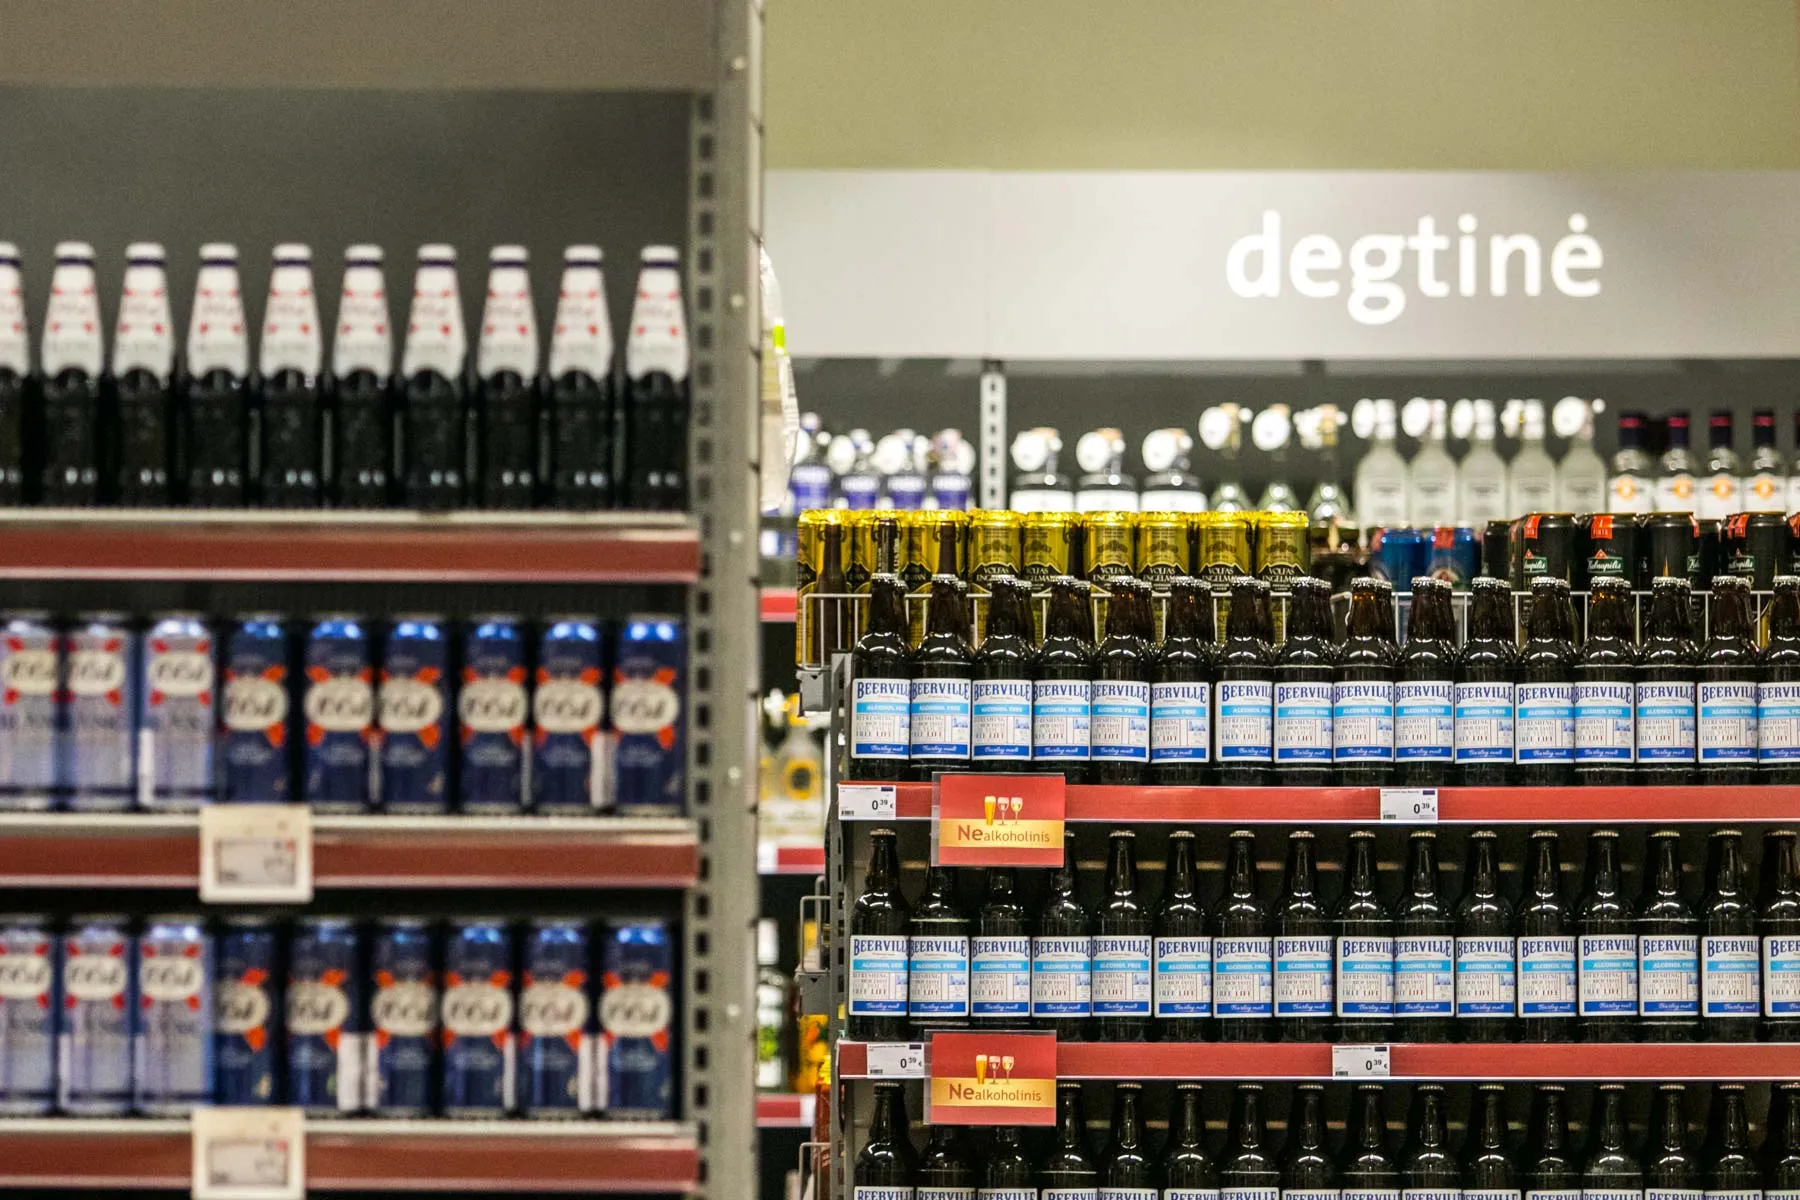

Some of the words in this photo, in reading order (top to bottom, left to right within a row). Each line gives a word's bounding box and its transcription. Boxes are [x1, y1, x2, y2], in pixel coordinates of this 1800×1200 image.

[1225, 210, 1603, 325] degtinė
[912, 682, 969, 700] BEERVILLE
[974, 684, 1031, 701] BEERVILLE
[1034, 684, 1089, 702] BEERVILLE
[1092, 684, 1148, 703] BEERVILLE
[1335, 685, 1392, 702] BEERVILLE
[1396, 685, 1452, 703] BEERVILLE
[1456, 686, 1512, 703] BEERVILLE
[1575, 686, 1631, 704] BEERVILLE
[1638, 686, 1695, 703] BEERVILLE
[872, 800, 879, 810] 0
[1413, 804, 1420, 814] 0
[958, 825, 1050, 843] Nealkoholinis
[973, 940, 1029, 957] BEERVILLE
[1034, 940, 1090, 958] BEERVILLE
[1093, 939, 1149, 957] BEERVILLE
[1458, 940, 1515, 958] BEERVILLE
[900, 1058, 907, 1068] 0
[1366, 1060, 1372, 1070] 0
[949, 1084, 1041, 1102] Nealkoholinis
